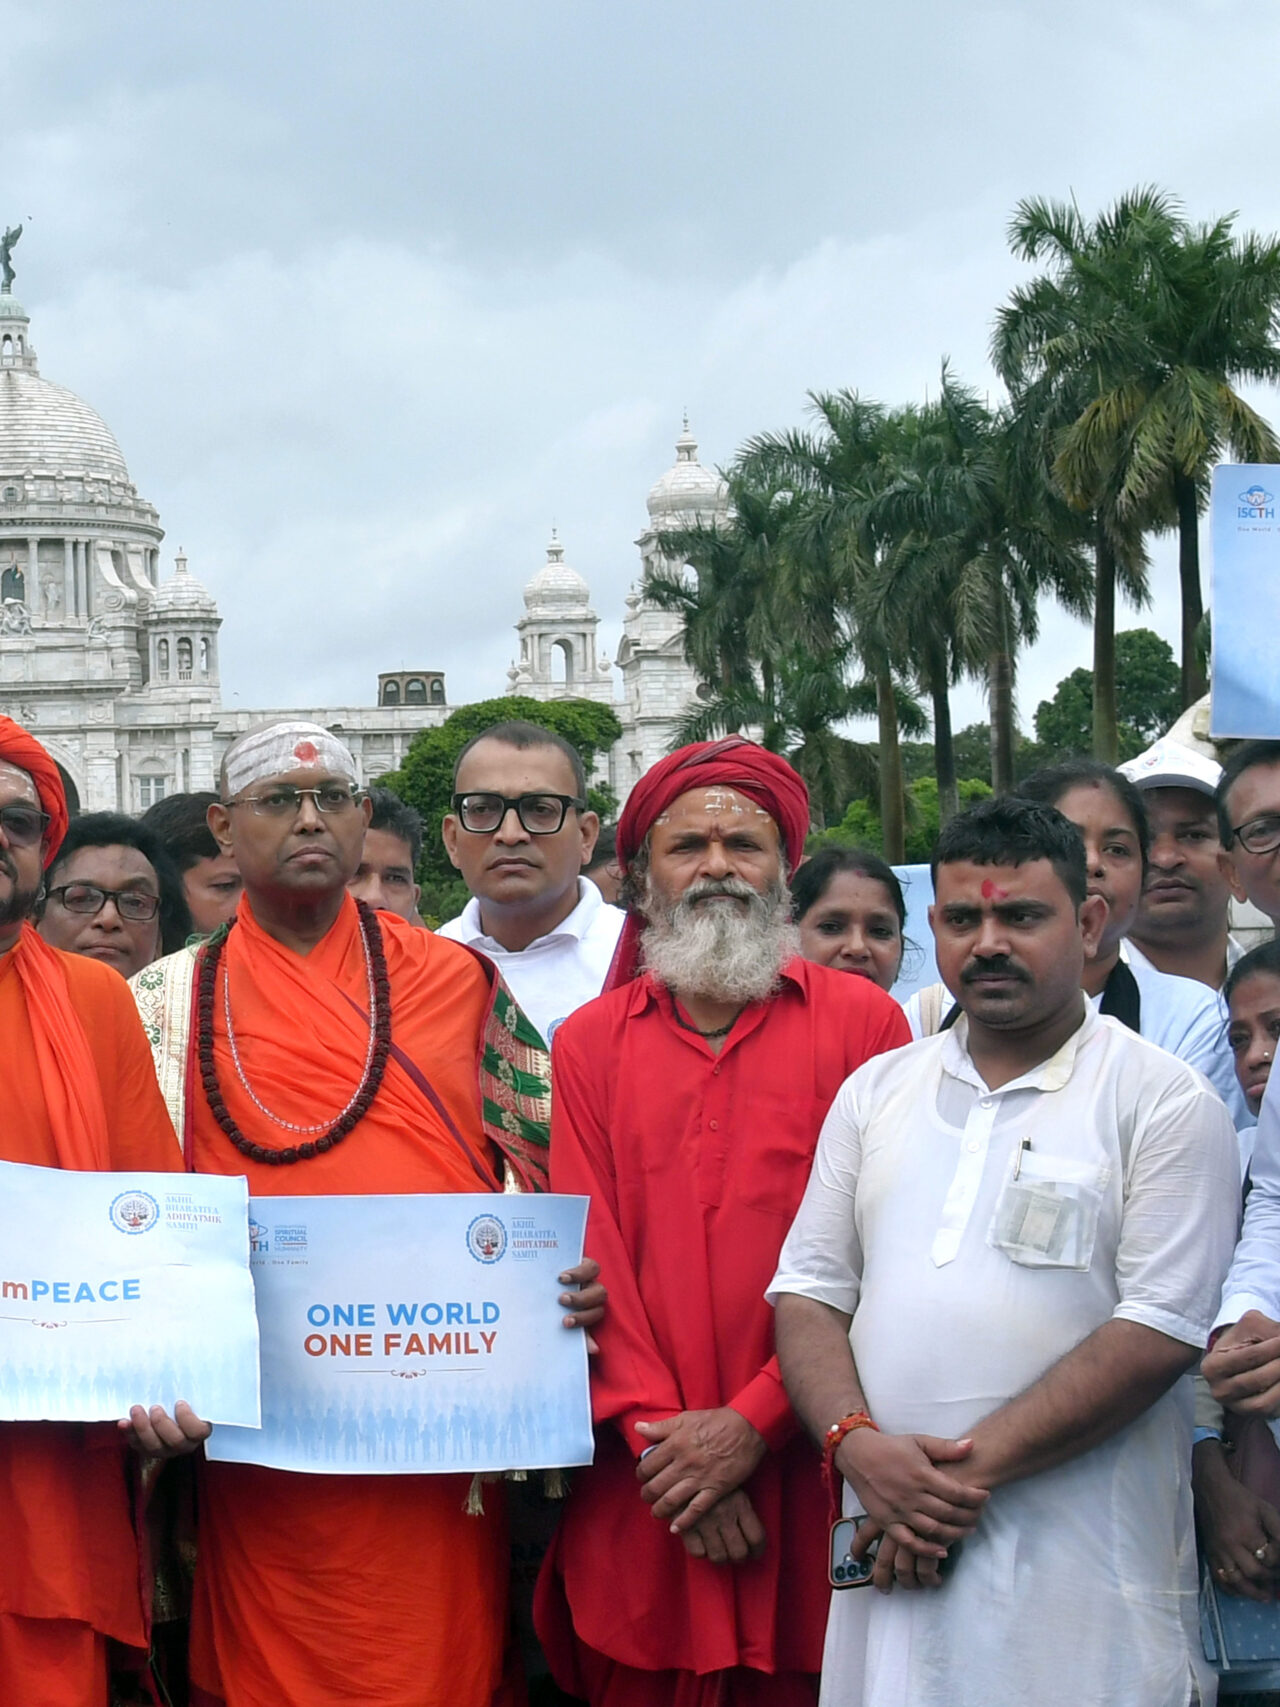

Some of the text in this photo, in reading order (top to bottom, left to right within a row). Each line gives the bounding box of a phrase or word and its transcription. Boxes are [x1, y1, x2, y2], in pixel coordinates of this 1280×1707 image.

[1237, 506, 1275, 519] iSCTH
[166, 1196, 193, 1204] AKHIL
[166, 1204, 219, 1215] BHARATIYA
[166, 1213, 222, 1224] ADHYATMIK
[166, 1222, 198, 1231] SAMITI
[512, 1220, 536, 1229] AKHIL
[512, 1230, 557, 1239] BHARATIYA
[512, 1239, 559, 1249] ADHYATMIK
[512, 1250, 538, 1258] SAMITI
[307, 1302, 500, 1327] ONE WORLD
[304, 1331, 497, 1356] ONE FAMILY
